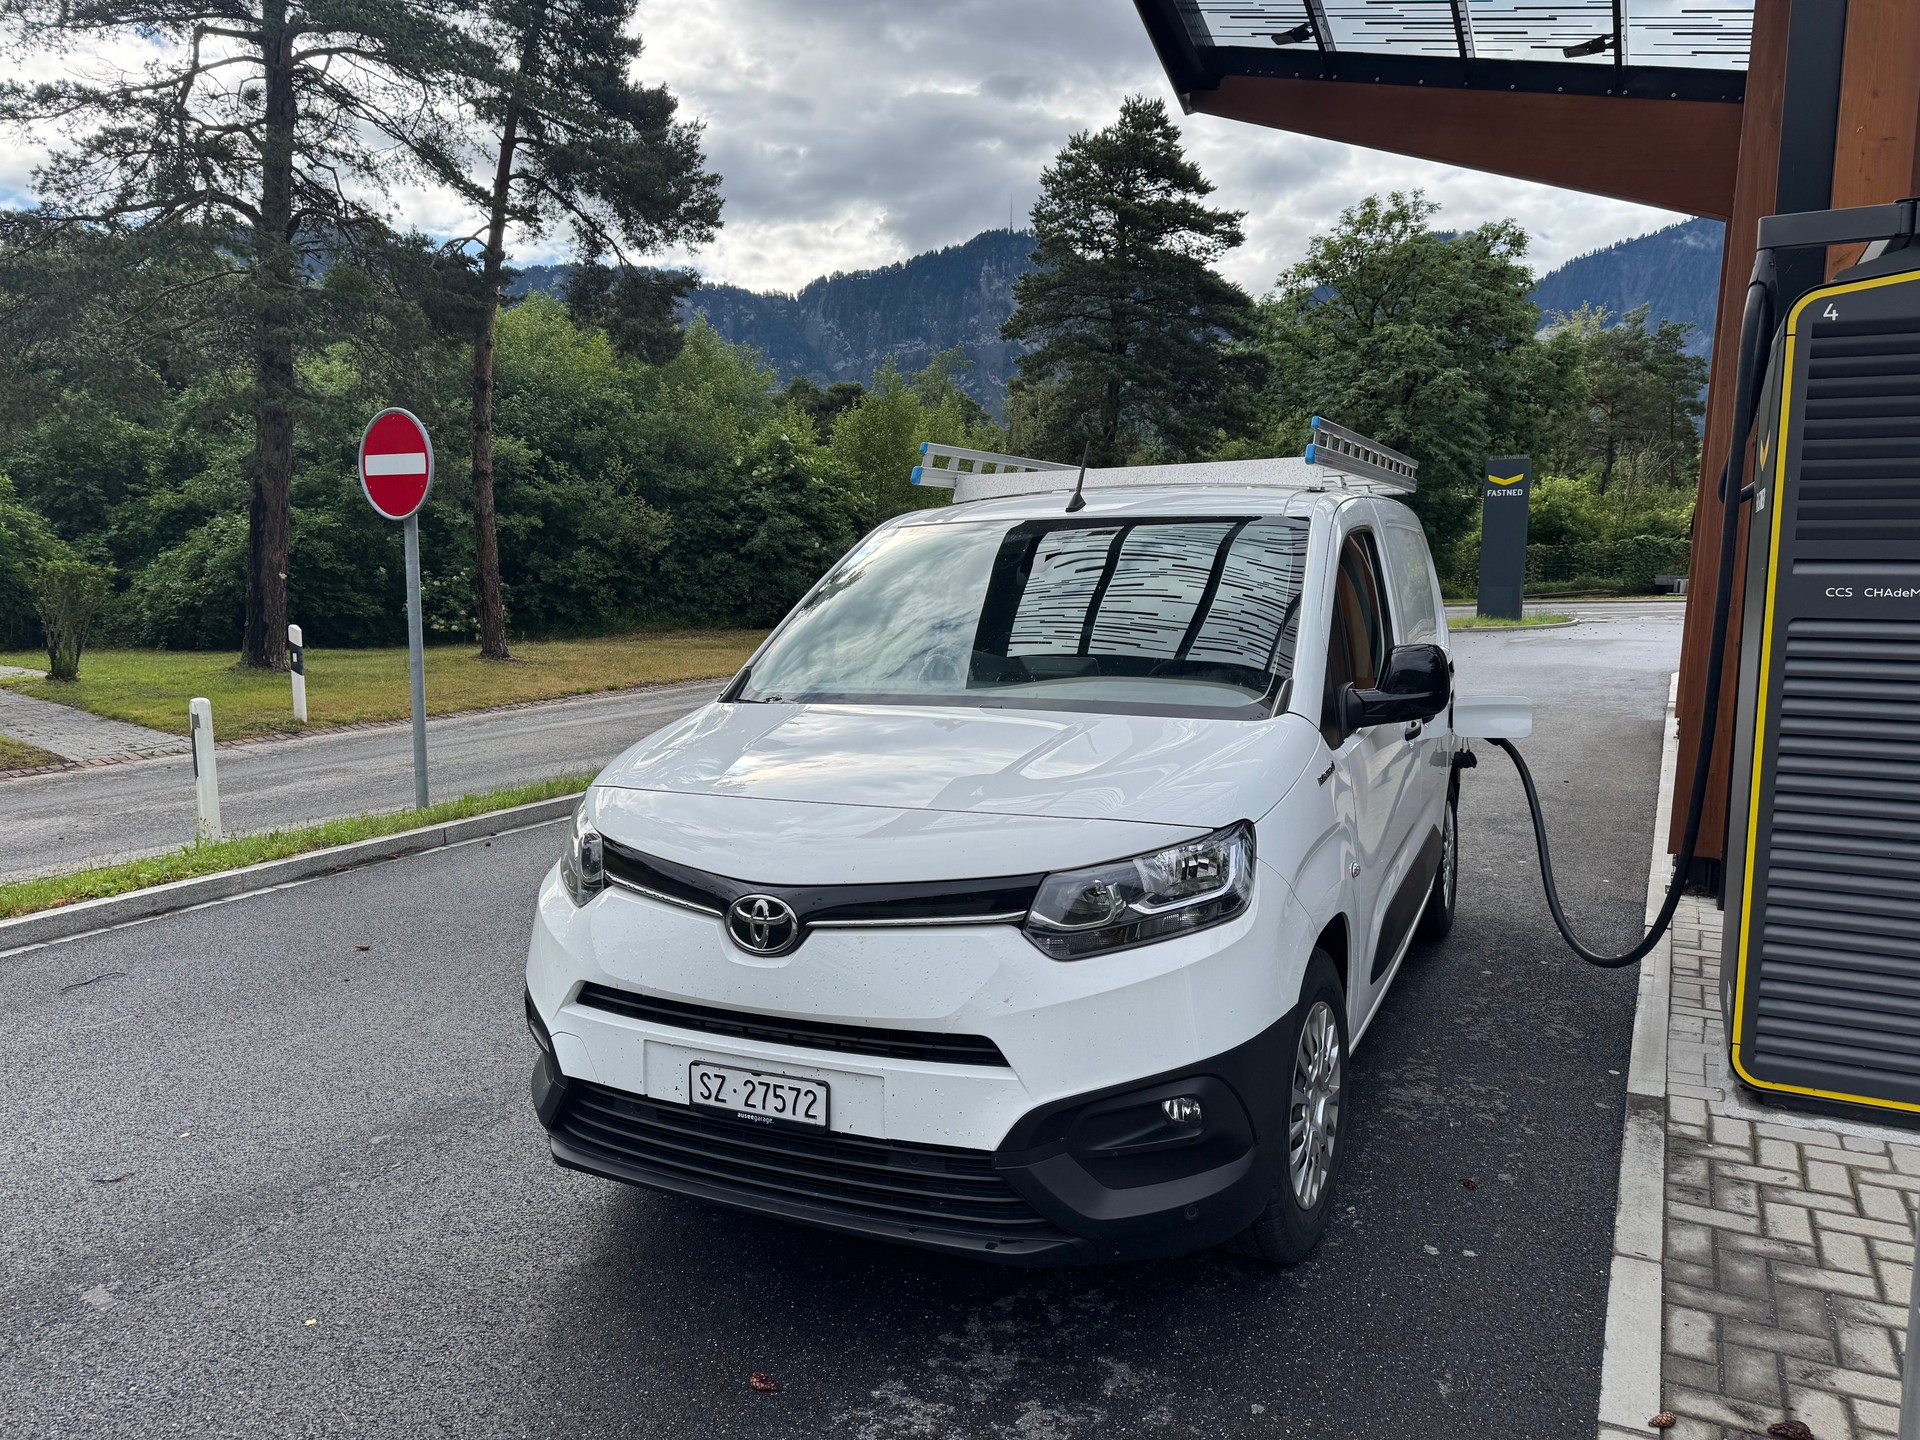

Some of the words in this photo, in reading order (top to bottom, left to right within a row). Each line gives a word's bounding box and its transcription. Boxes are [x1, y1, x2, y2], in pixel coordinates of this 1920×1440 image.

[1823, 303, 1839, 321] 4
[1487, 488, 1524, 497] FASTNED
[1825, 587, 1853, 598] CCS
[743, 1079, 818, 1120] 27572
